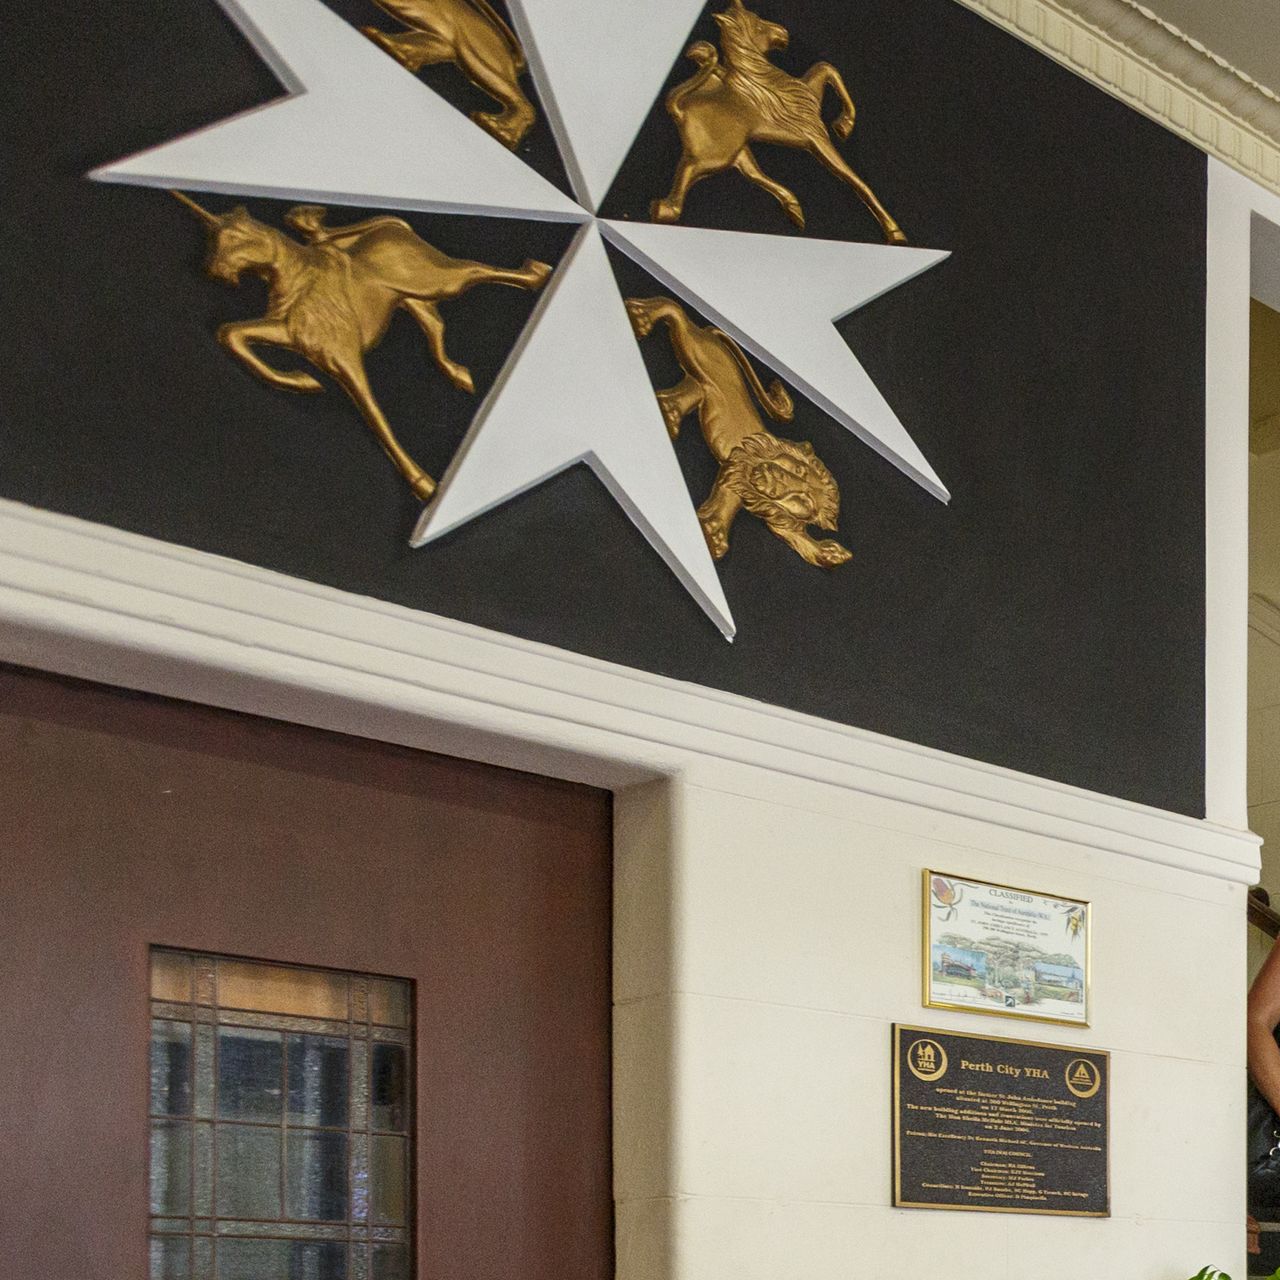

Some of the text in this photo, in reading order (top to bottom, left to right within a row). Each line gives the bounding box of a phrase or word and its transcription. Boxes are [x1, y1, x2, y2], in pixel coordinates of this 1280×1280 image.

[989, 889, 1034, 904] CLASSIFIED
[917, 1061, 936, 1069] YHA
[960, 1060, 1050, 1079] Perth City YHA
